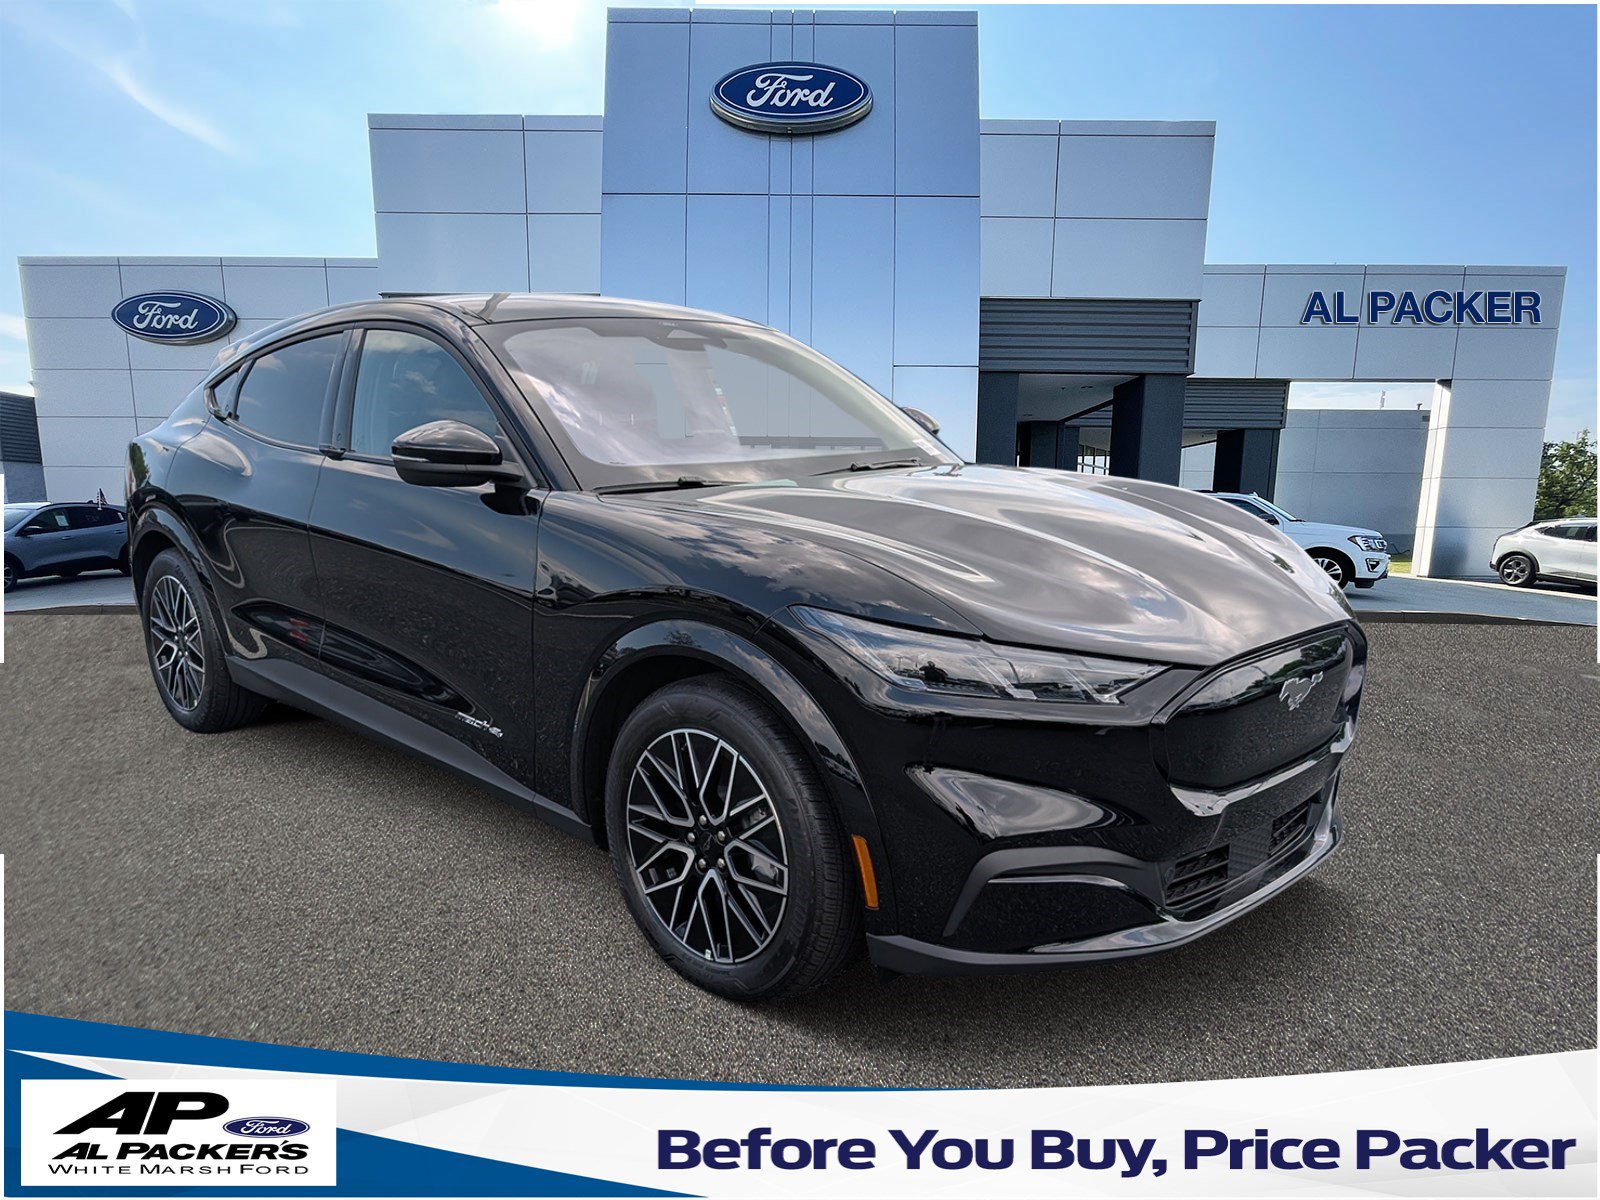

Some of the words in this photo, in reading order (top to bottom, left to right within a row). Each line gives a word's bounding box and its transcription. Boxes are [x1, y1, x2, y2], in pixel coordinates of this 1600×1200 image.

[746, 73, 836, 108] Ford
[133, 301, 199, 329] Ford
[1301, 290, 1359, 324] AL
[1367, 290, 1542, 325] PACKER
